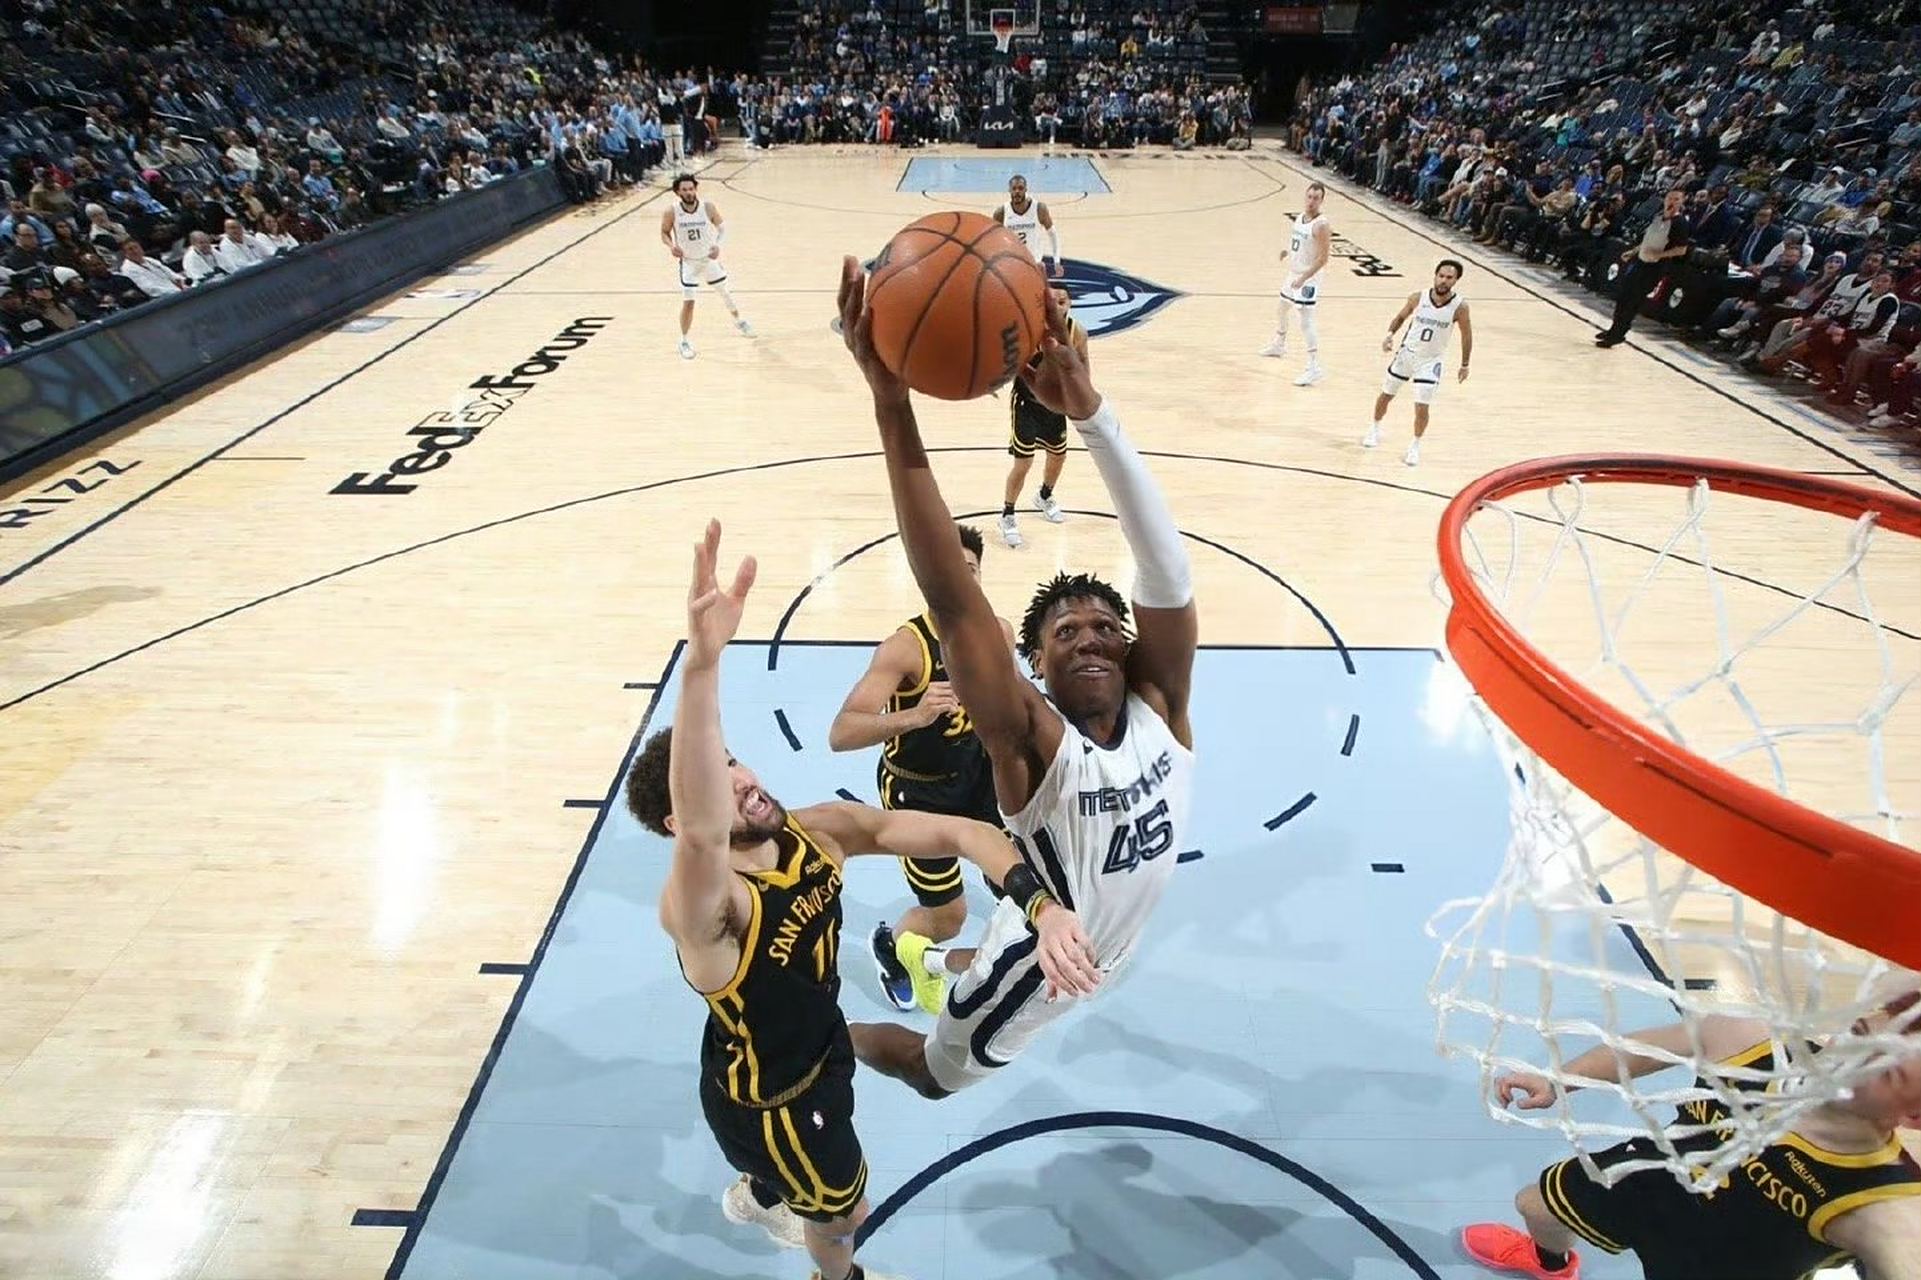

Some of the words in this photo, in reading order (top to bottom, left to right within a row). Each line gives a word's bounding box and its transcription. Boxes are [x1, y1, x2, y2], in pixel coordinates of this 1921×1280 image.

[687, 228, 702, 241] 21
[1420, 328, 1434, 342] 0
[328, 317, 614, 495] FedExForum
[1101, 798, 1174, 875] 45
[768, 918, 802, 967] SAN
[812, 917, 835, 982] 11
[1785, 1151, 1827, 1198] Rakuten
